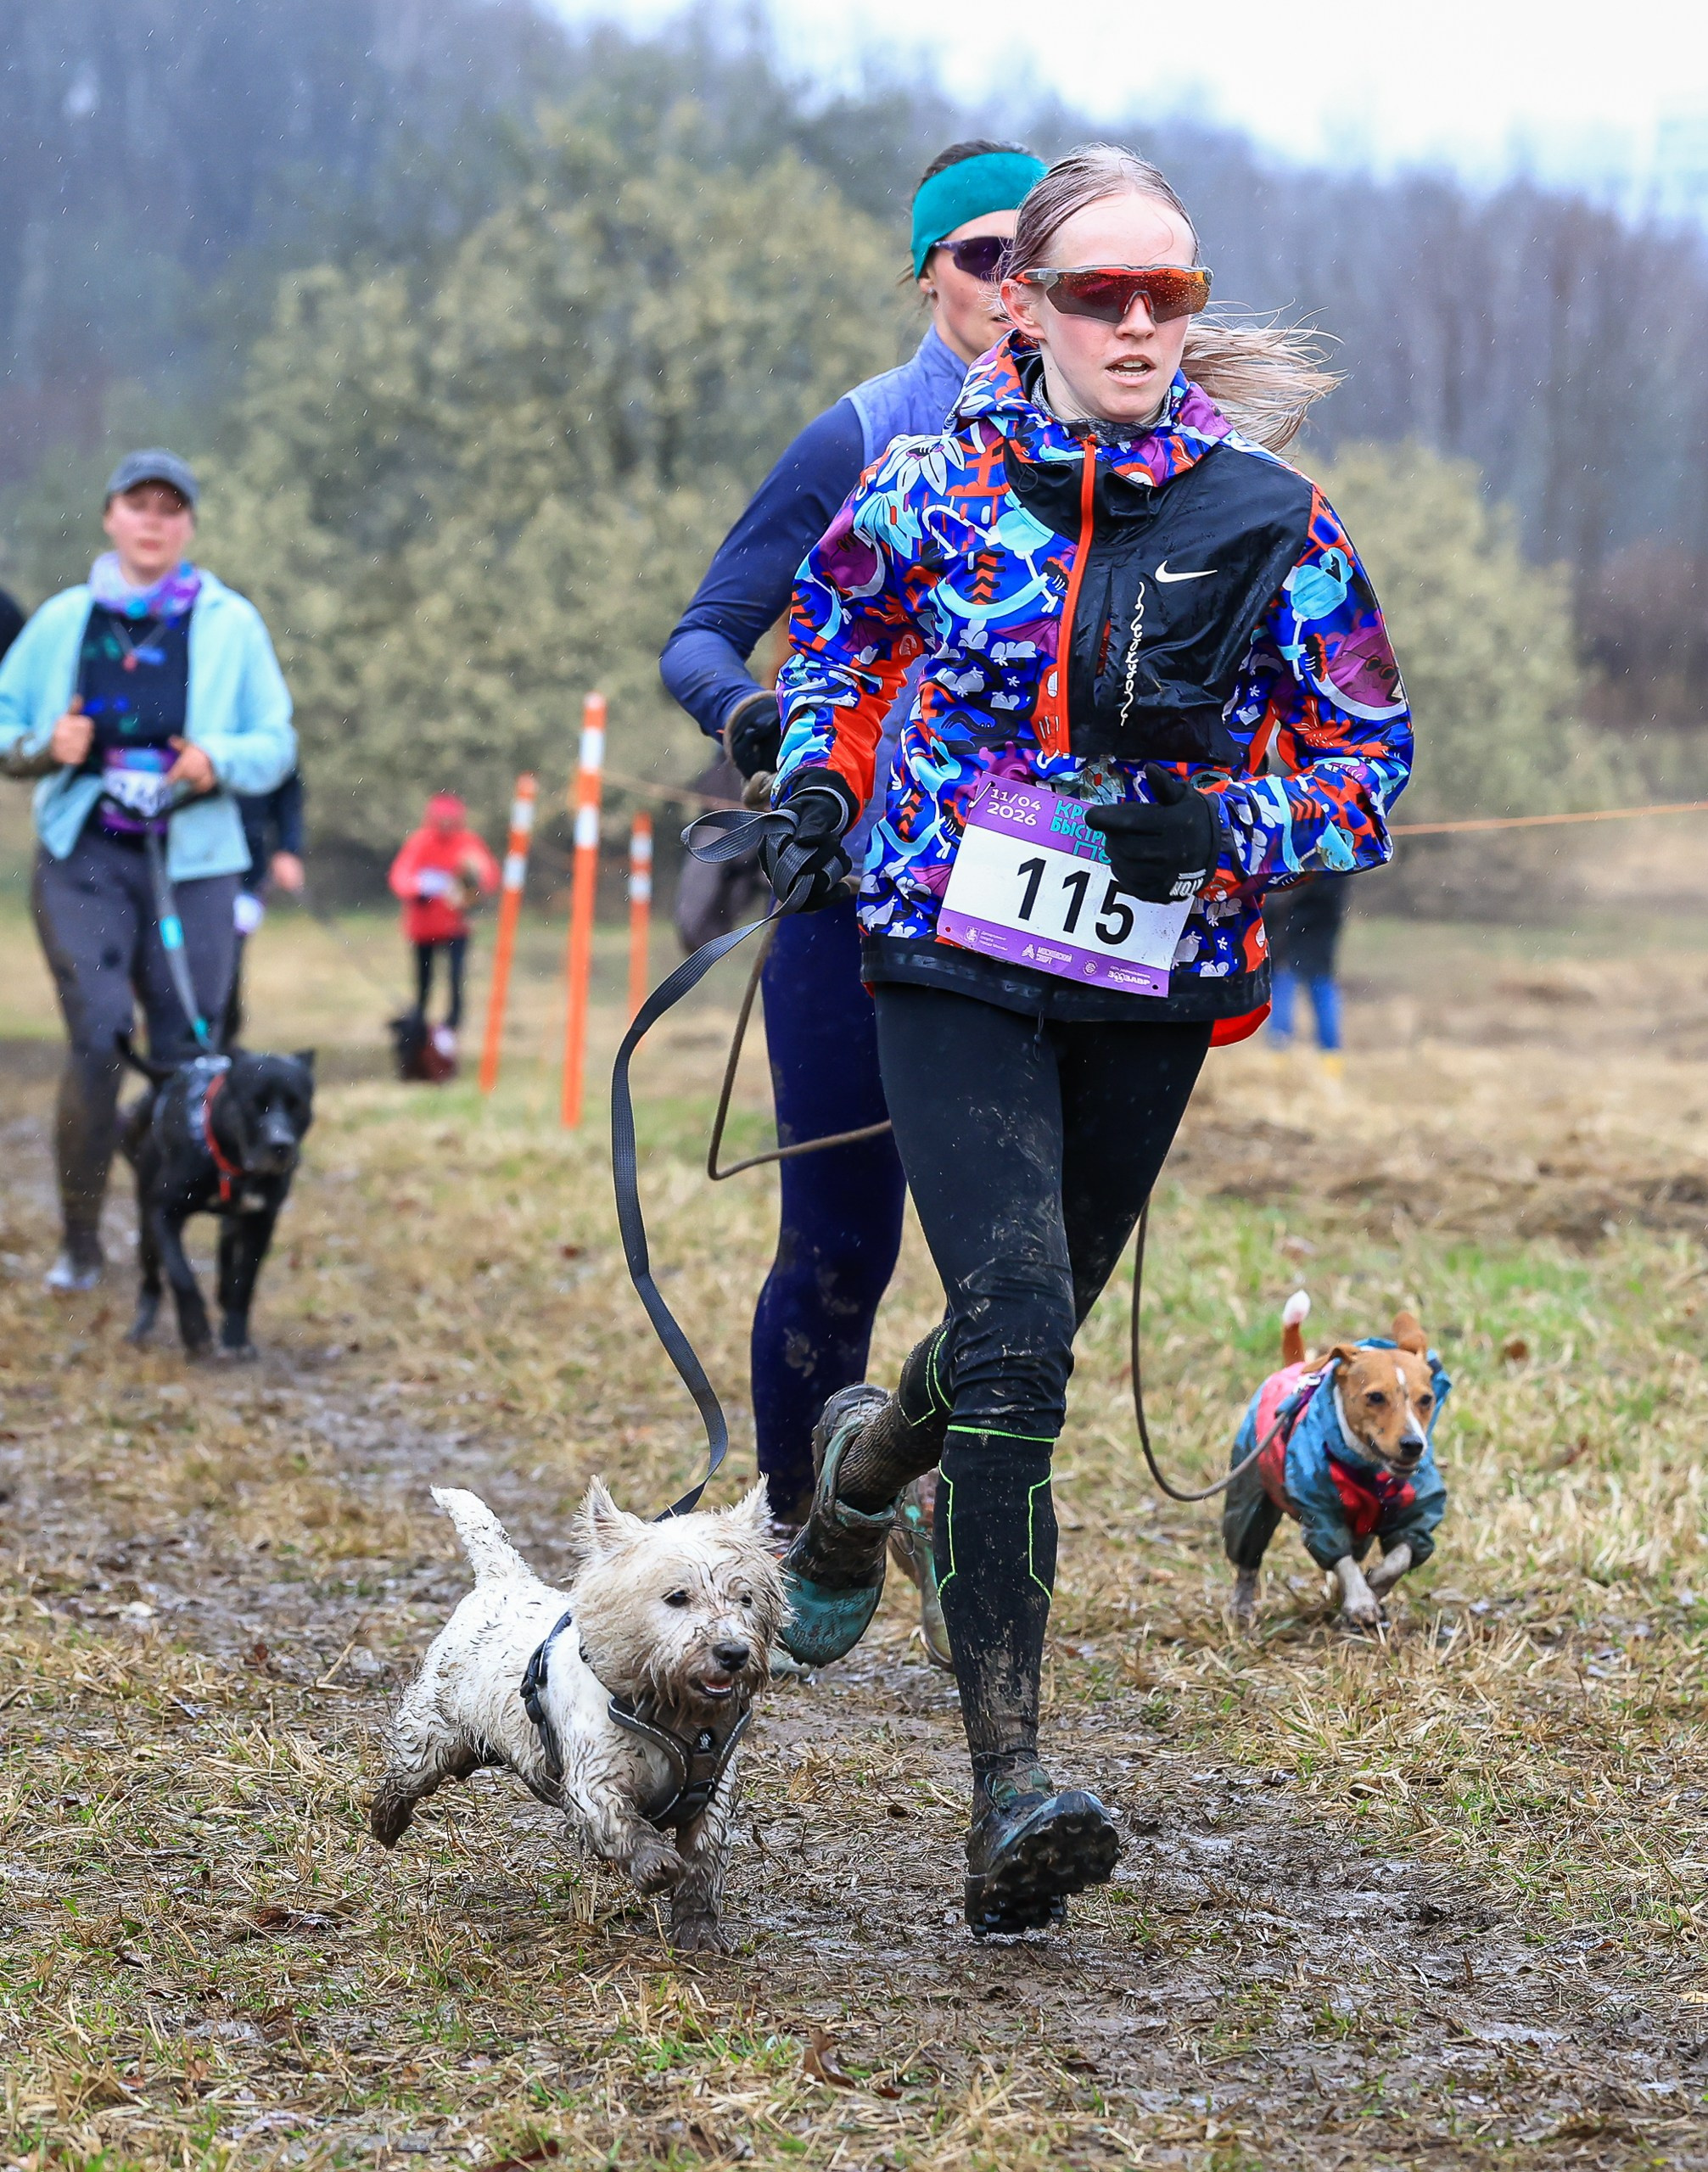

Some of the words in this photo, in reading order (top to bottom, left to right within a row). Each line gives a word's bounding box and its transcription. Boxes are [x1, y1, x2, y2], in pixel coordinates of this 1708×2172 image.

[990, 788, 1042, 811] 11/04
[1055, 799, 1089, 822] КР
[987, 801, 1037, 826] 2026
[1050, 815, 1107, 847] БЫСТР
[1016, 857, 1134, 945] 115
